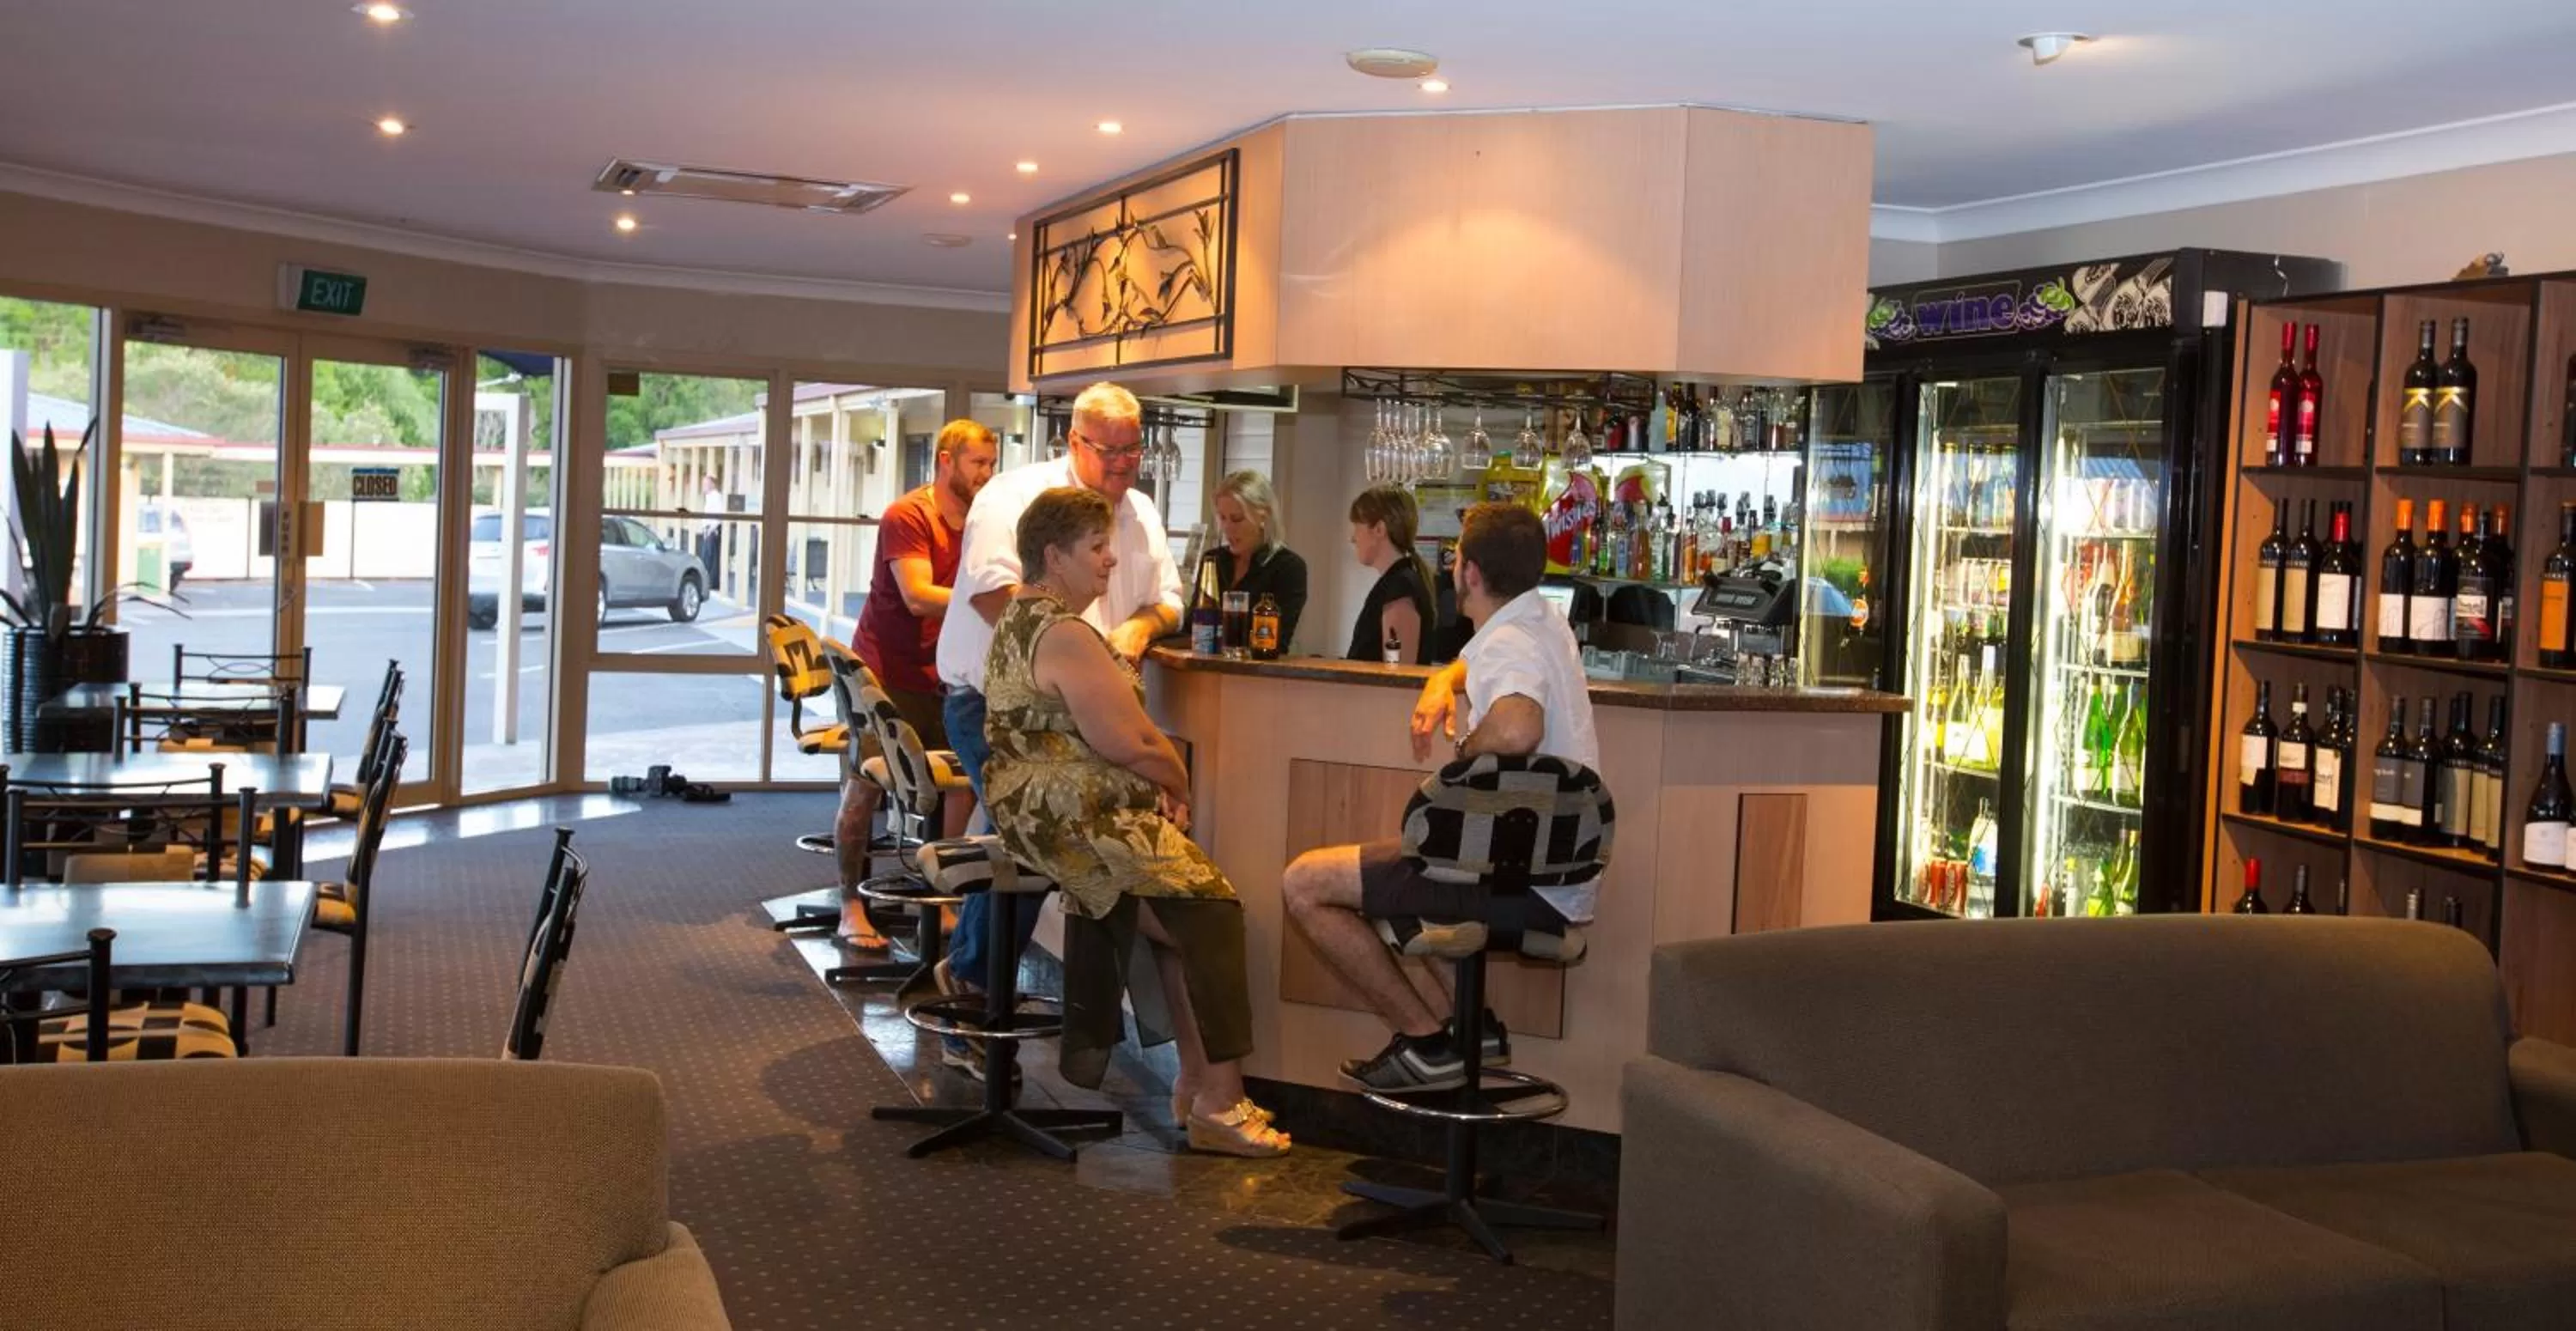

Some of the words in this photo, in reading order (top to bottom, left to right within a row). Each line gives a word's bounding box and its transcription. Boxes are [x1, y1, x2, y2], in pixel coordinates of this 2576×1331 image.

[310, 277, 355, 307] EXIT
[1915, 291, 2014, 335] wine
[353, 476, 398, 495] CLOSED
